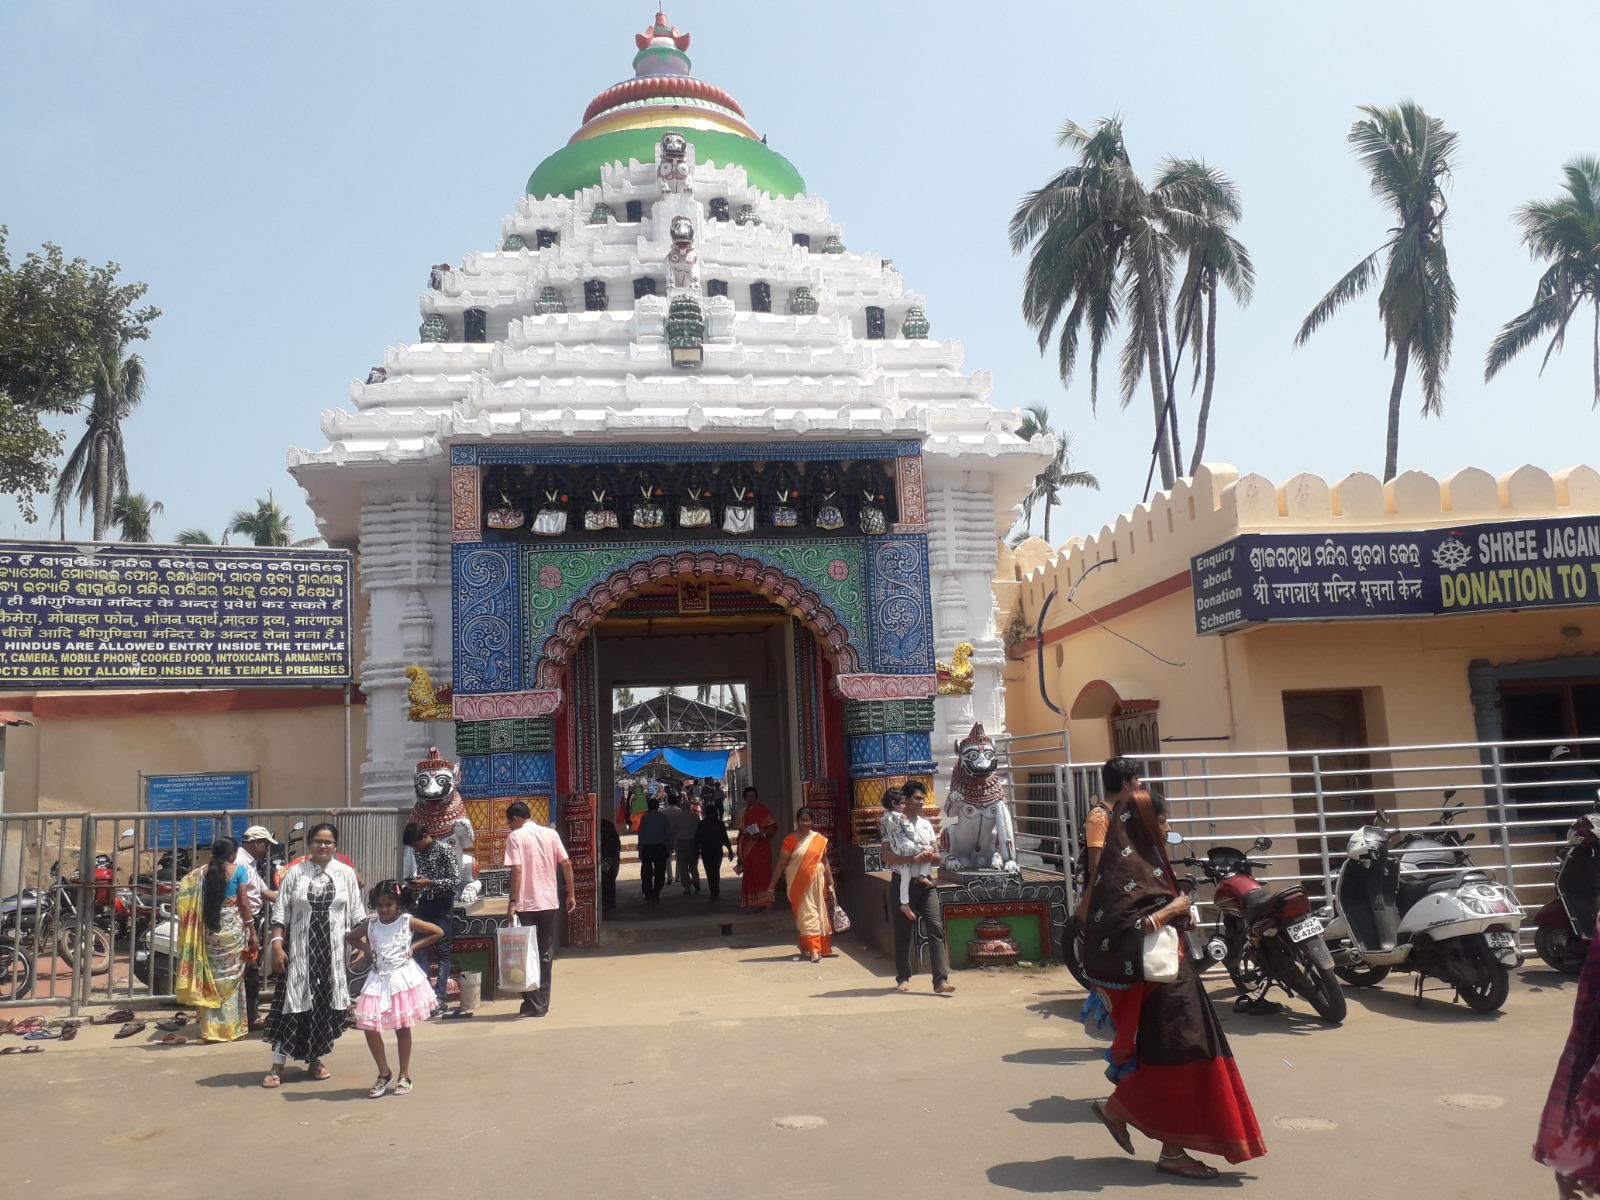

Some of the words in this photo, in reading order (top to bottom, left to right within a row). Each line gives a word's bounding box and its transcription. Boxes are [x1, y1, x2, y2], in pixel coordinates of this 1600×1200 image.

[1315, 539, 1348, 567] ମନ୍ଦିର
[1478, 530, 1539, 564] SHREE
[1197, 547, 1236, 572] Enquiry
[1203, 567, 1233, 589] about
[1440, 567, 1554, 608] DONATION
[1557, 564, 1587, 599] TO
[1197, 587, 1243, 612] Donation
[1253, 576, 1270, 604] श्री
[1272, 583, 1320, 604] जगन्नाथ
[1322, 573, 1357, 603] मन्दिर
[1360, 581, 1395, 608] सूचना
[1397, 571, 1423, 600] केन्द्र
[7, 595, 24, 606] ही
[157, 597, 174, 608] के
[262, 601, 285, 610] कर
[290, 599, 327, 610] सकते
[48, 610, 100, 626] मोबाइल
[144, 611, 182, 625] भोजन
[1201, 609, 1242, 630] Scheme
[39, 627, 73, 639] आदि
[200, 628, 216, 639] के
[262, 628, 291, 640] लेना
[5, 642, 61, 651] HINDUS
[65, 642, 95, 651] ARE
[99, 642, 165, 651] ALLOWED
[169, 643, 213, 651] ENTRY
[218, 642, 262, 651] INSIDE
[265, 643, 291, 651] THE
[295, 642, 345, 651] TEMPLE
[11, 653, 58, 665] CAMERA,
[61, 653, 100, 663] MOBILE
[104, 653, 138, 663] PHONE
[141, 653, 182, 663] COOKED
[185, 653, 214, 665] FOOD,
[217, 653, 283, 665] INTOXICANTS,
[285, 653, 343, 662] ARMAMENTS
[33, 666, 60, 676] ARE
[64, 666, 92, 676] NOT
[95, 666, 157, 676] ALLOWED
[161, 666, 203, 676] INSIDE
[207, 666, 231, 676] THE
[235, 666, 283, 675] TEMPLE
[286, 666, 345, 675] PREMISES
[1294, 926, 1322, 941] G-4209
